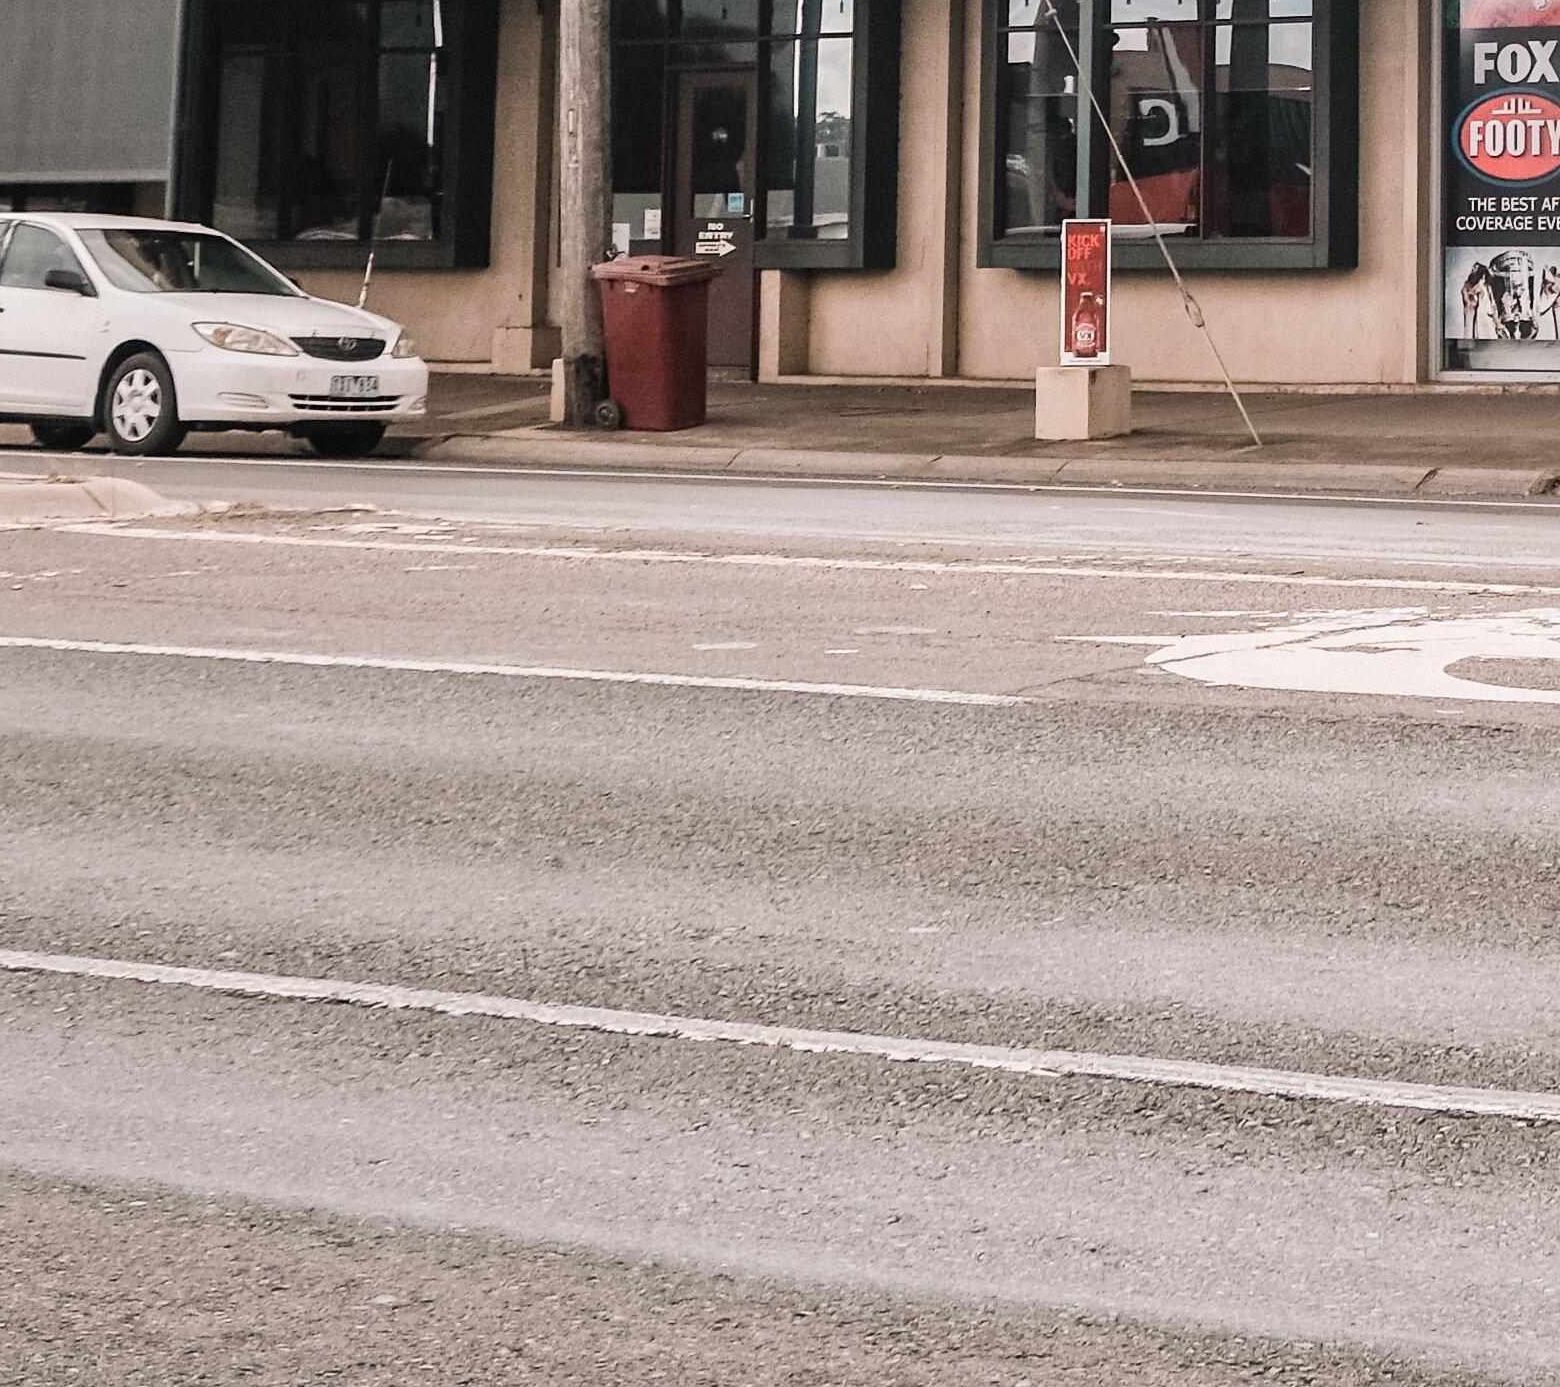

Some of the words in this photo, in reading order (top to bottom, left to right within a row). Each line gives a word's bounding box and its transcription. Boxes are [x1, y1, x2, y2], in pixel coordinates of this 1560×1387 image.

[1473, 39, 1560, 85] FOX
[1468, 196, 1497, 212] THE
[1500, 196, 1538, 212] BEST
[1455, 216, 1533, 231] COVERAGE
[1067, 233, 1101, 248] KICK
[1067, 246, 1092, 261] OFF
